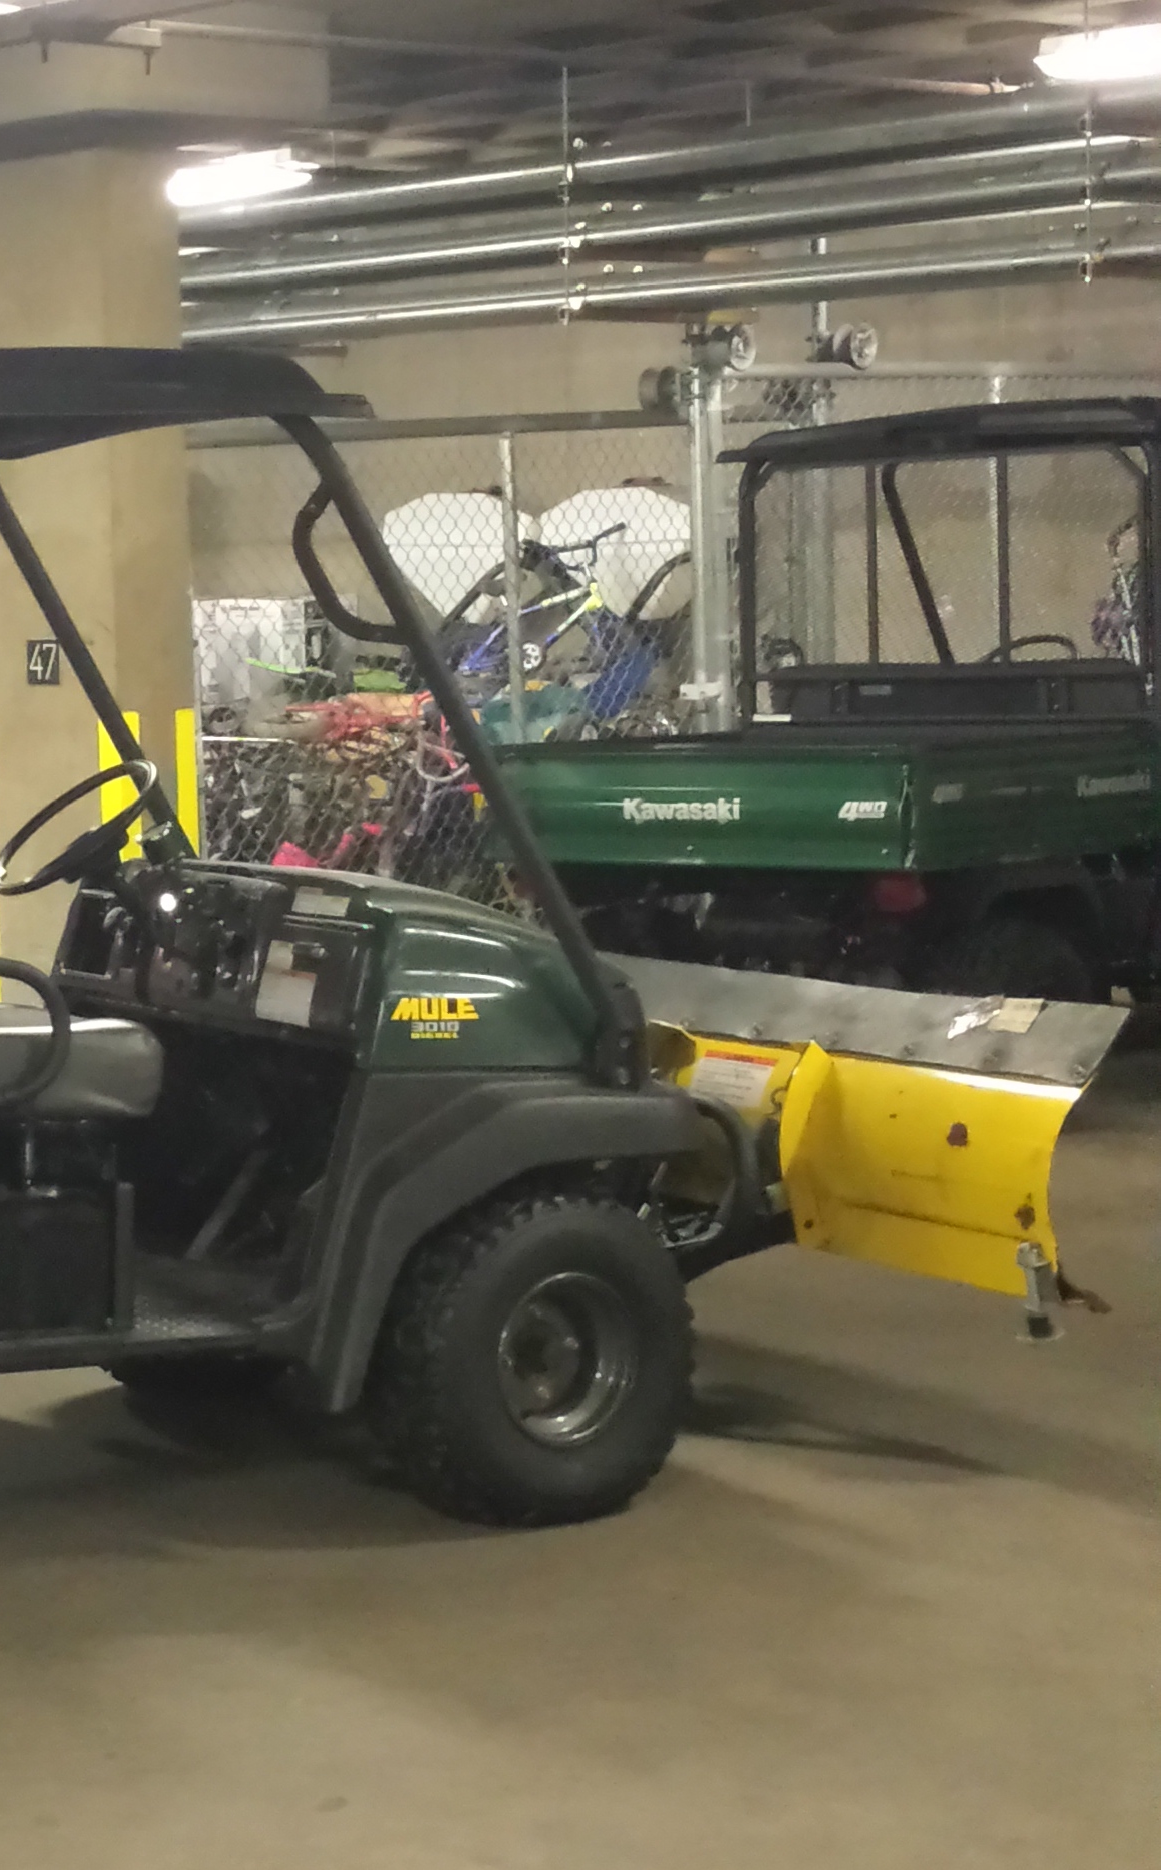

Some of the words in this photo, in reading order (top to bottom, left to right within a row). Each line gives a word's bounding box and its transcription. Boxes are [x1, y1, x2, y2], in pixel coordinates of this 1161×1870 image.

[29, 643, 56, 680] 47
[623, 797, 741, 821] Kawasaki
[390, 997, 479, 1021] MULE
[410, 1021, 460, 1032] 3010
